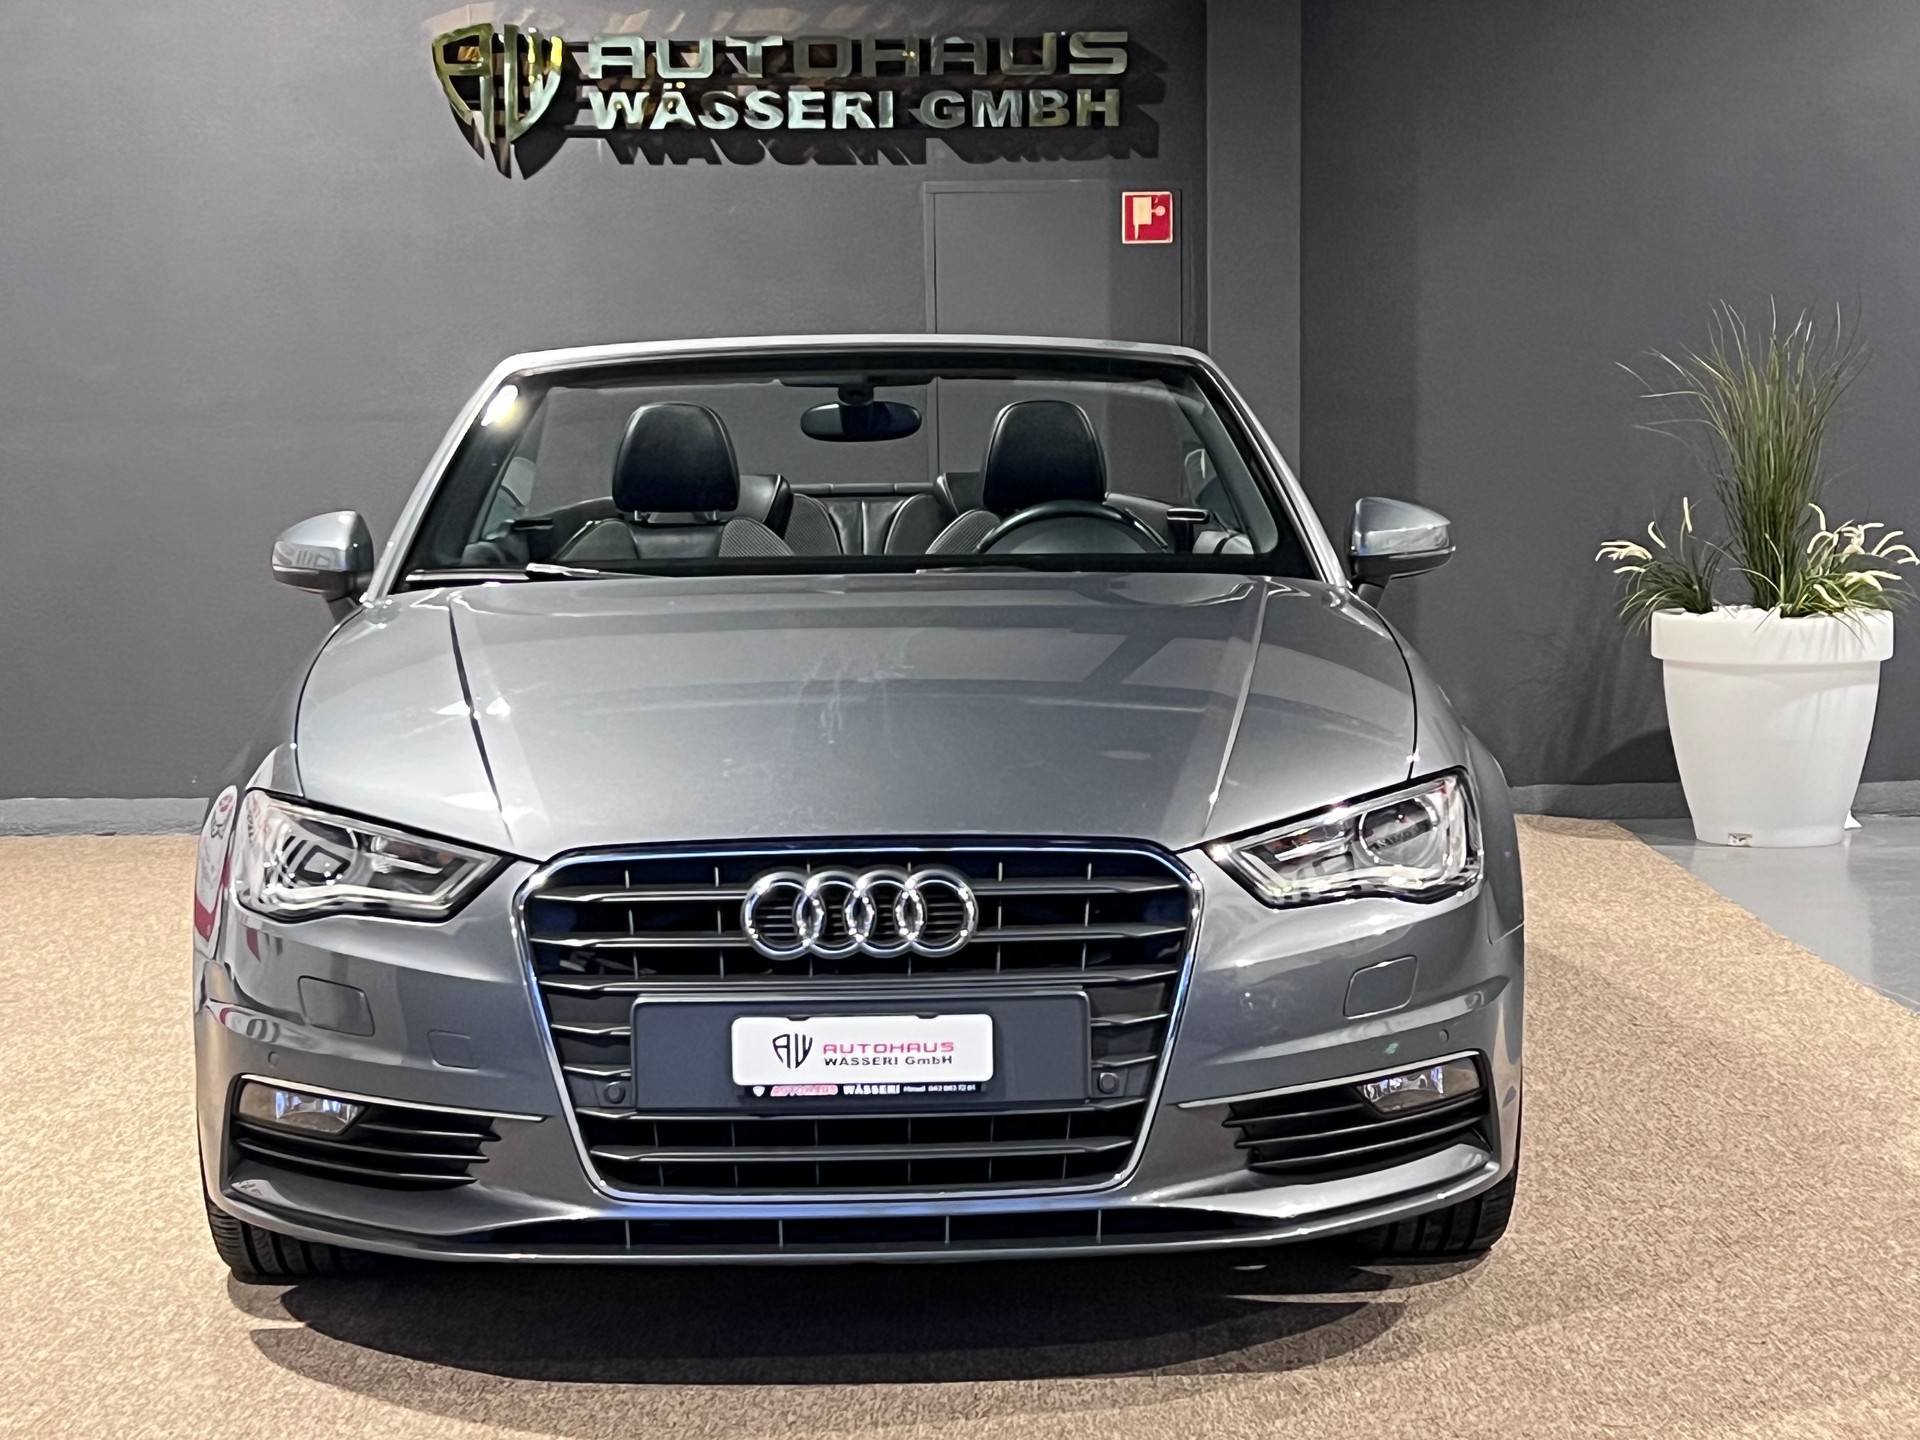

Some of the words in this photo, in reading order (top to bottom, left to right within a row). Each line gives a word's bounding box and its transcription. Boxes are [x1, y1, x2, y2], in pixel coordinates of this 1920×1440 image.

[589, 31, 1128, 79] AUTOHAUS
[588, 82, 894, 130] WÄSSERI
[920, 89, 1120, 129] GMBH
[823, 1041, 955, 1055] AUTOHAUS
[905, 1055, 953, 1066] GmbH
